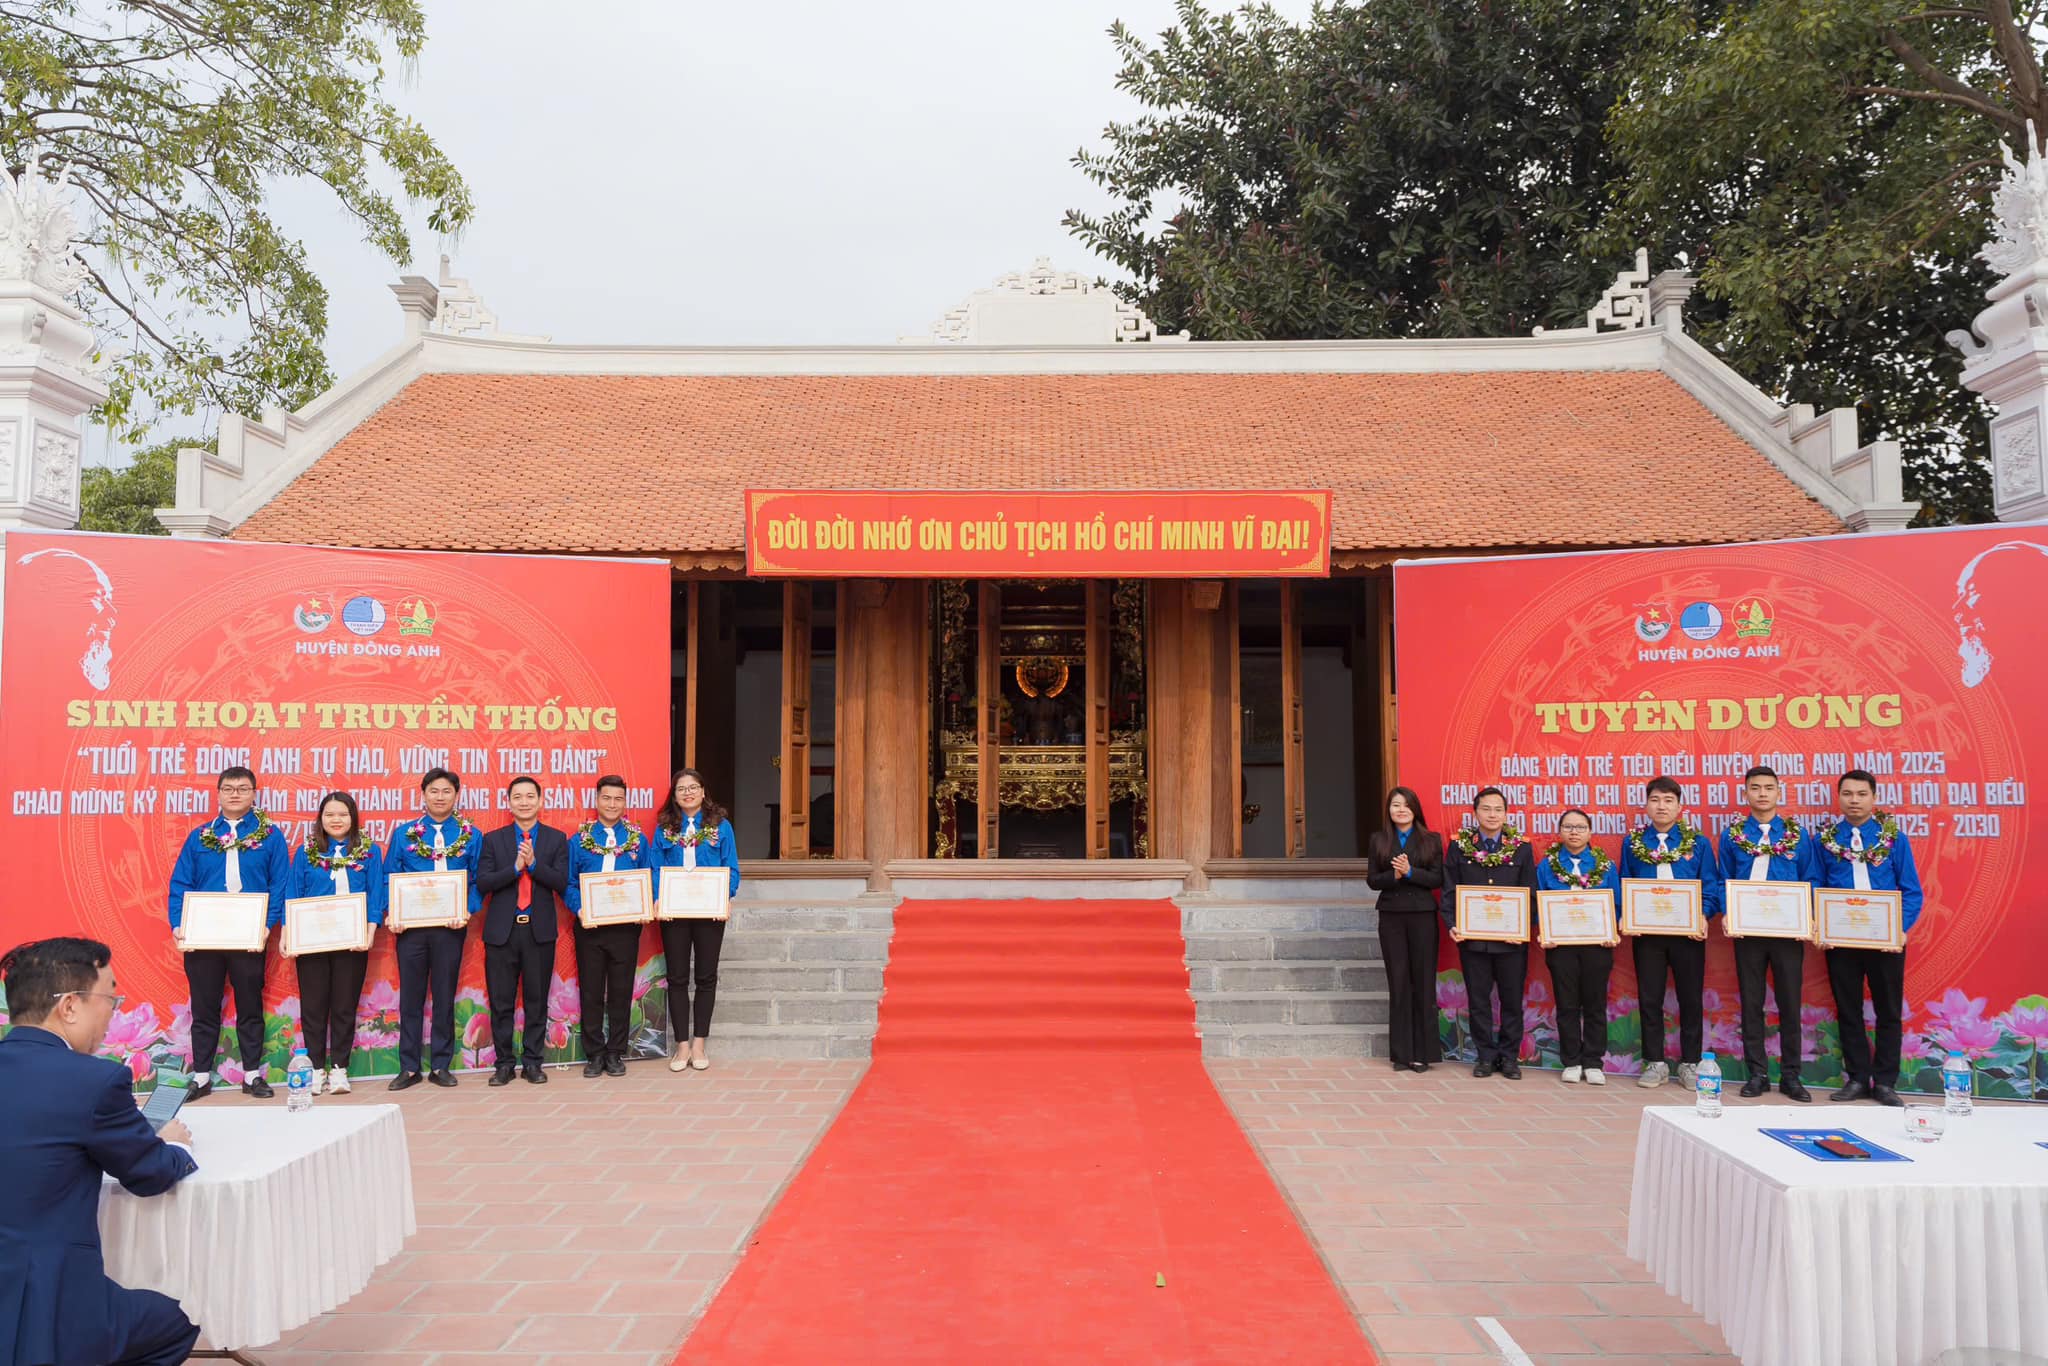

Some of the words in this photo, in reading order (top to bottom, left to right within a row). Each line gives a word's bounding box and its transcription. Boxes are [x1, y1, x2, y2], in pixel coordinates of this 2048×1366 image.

[768, 513, 808, 549] ĐỜI
[815, 513, 855, 550] ĐỜI
[862, 515, 912, 550] NHỚ
[919, 518, 952, 550] ƠN
[960, 512, 1007, 550] CHỦ
[1014, 521, 1067, 557] TỊCH
[1075, 511, 1106, 551] HỒ
[1114, 515, 1154, 550] CHÍ
[1161, 521, 1224, 550] MINH
[1232, 514, 1256, 550] VĨ
[1261, 520, 1310, 556] ĐẠI!
[295, 640, 348, 657] HUYỆN
[353, 640, 402, 656] ĐÔNG
[406, 645, 440, 657] ANH
[1638, 645, 1687, 663] HUYỆN
[1692, 645, 1740, 660] ĐÔNG
[1744, 645, 1780, 657] ANH
[67, 699, 177, 728] SINH
[185, 700, 306, 735] HOẠT
[314, 693, 477, 730] TRUYỀN
[484, 696, 616, 731] THỐNG
[1535, 691, 1697, 733] TUYÊN
[1707, 693, 1902, 730] DƯƠNG
[148, 742, 187, 775] TRẺ
[195, 743, 250, 775] ĐÔNG
[260, 747, 301, 775] ANH
[310, 747, 337, 778] TỰ
[345, 744, 390, 777] HÀO,
[400, 744, 449, 775] VỮNG
[458, 748, 488, 775] TIN
[496, 748, 542, 775] THEO
[1501, 752, 1540, 777] ĐẢNG
[1546, 754, 1579, 777] VIÊN
[1585, 752, 1613, 777] TRẺ
[1621, 753, 1654, 777] TIÊU
[1661, 750, 1695, 777] BIỂU
[1702, 752, 1753, 778] HUYỆN
[1812, 752, 1846, 776] ANH
[1853, 749, 1893, 775] NĂM
[1901, 751, 1945, 775] 2025
[13, 788, 62, 815] CHÀO
[71, 788, 125, 815] MỪNG
[133, 786, 157, 814] KỶ
[165, 787, 209, 816] NIỆM
[296, 786, 340, 812] NGÀ
[348, 786, 402, 811] THÀNH
[454, 784, 490, 810] ẢNG
[544, 784, 574, 809] SẢN
[1441, 782, 1478, 805] CHÀO
[1485, 782, 1526, 805] ỪNG
[1533, 783, 1558, 808] ĐẠI
[1564, 782, 1589, 808] HỘI
[1595, 784, 1620, 806] CHI
[1707, 781, 1729, 809] BỘ
[1794, 779, 1832, 806] TIẾN
[1911, 780, 1940, 808] HỘI
[1948, 782, 1978, 809] ĐẠI
[1985, 777, 2025, 806] BIỂU
[1895, 813, 1929, 837] 025
[1953, 813, 1999, 837] 2030
